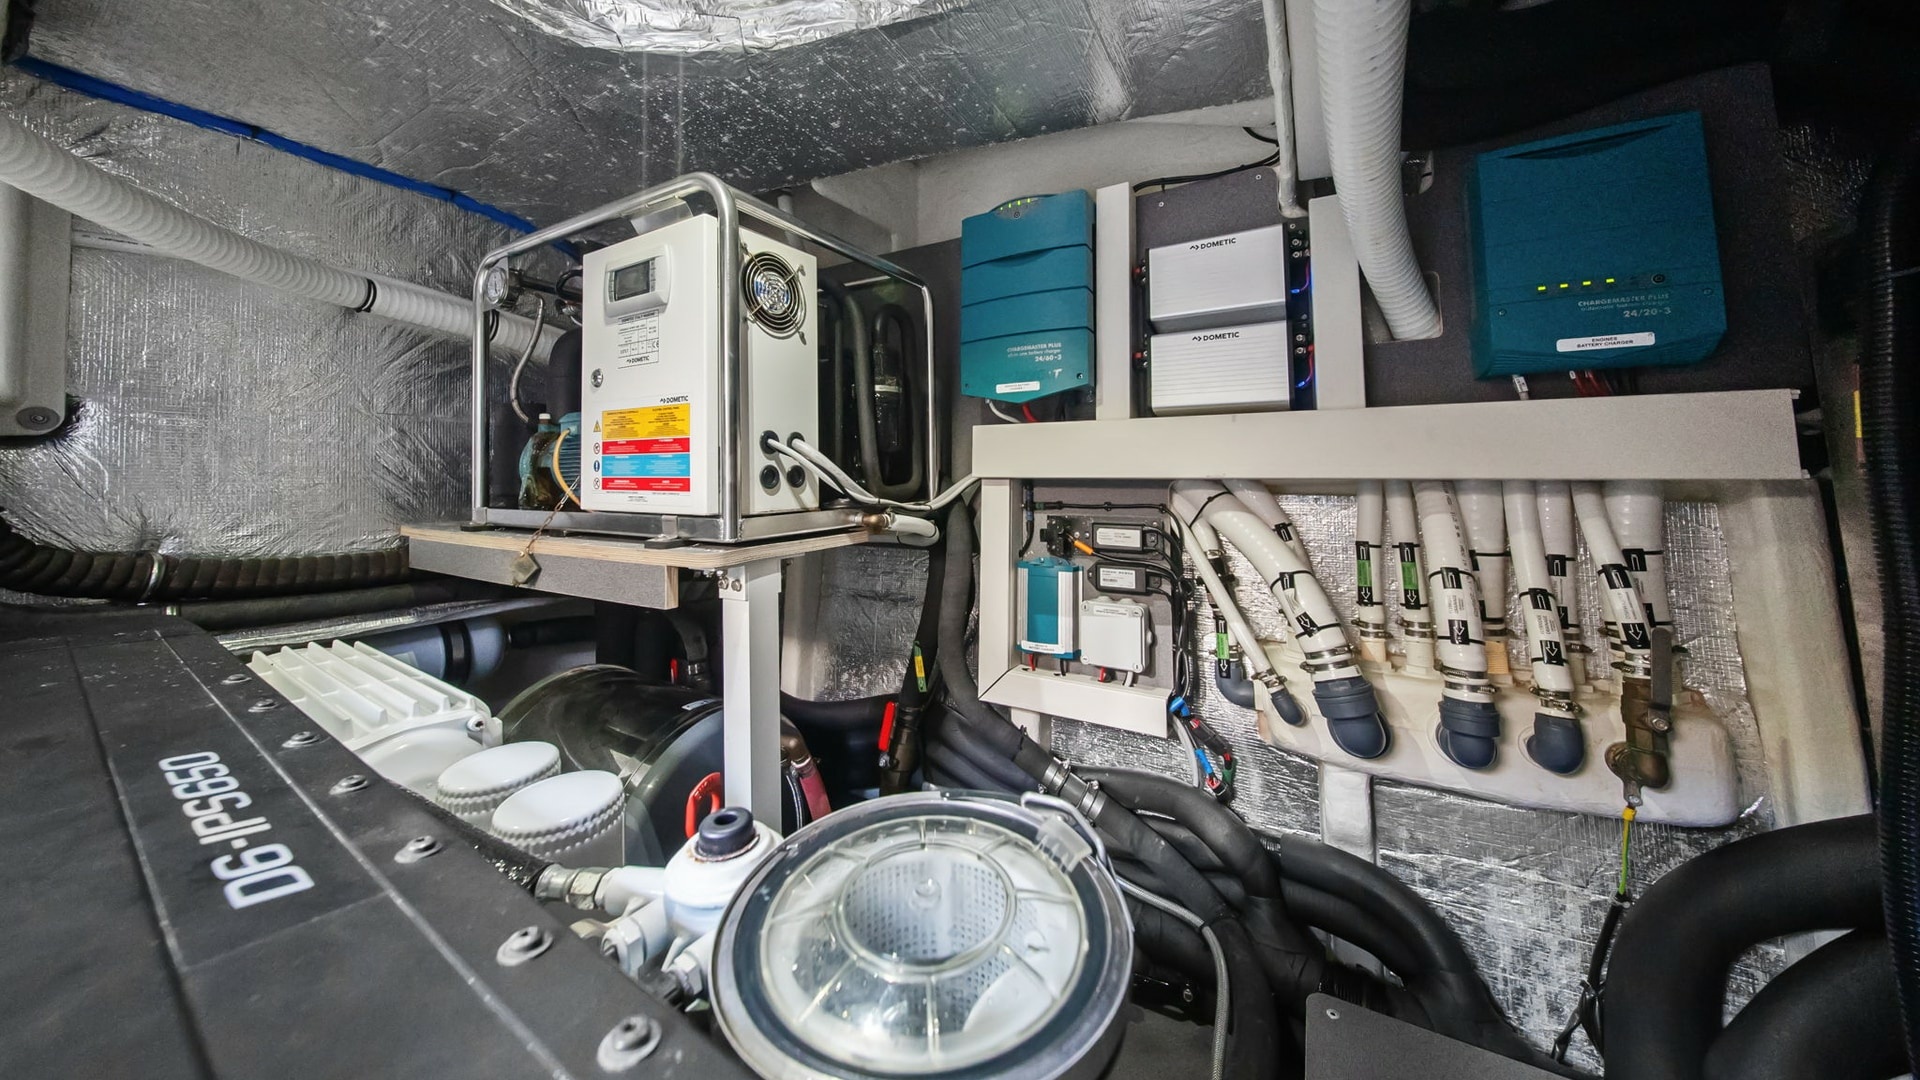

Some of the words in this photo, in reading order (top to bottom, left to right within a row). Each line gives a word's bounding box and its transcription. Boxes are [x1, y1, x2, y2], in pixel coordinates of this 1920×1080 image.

[1200, 238, 1237, 250] DOMETIC
[1578, 296, 1645, 307] CHARGEMASTER
[1647, 293, 1669, 301] PLUS
[1623, 307, 1672, 318] 24/20-3
[1203, 331, 1240, 342] DOMETIC
[1007, 343, 1047, 352] CHARGEMASTER
[666, 395, 689, 403] DOMETIC
[158, 751, 315, 910] D6-IPS650
